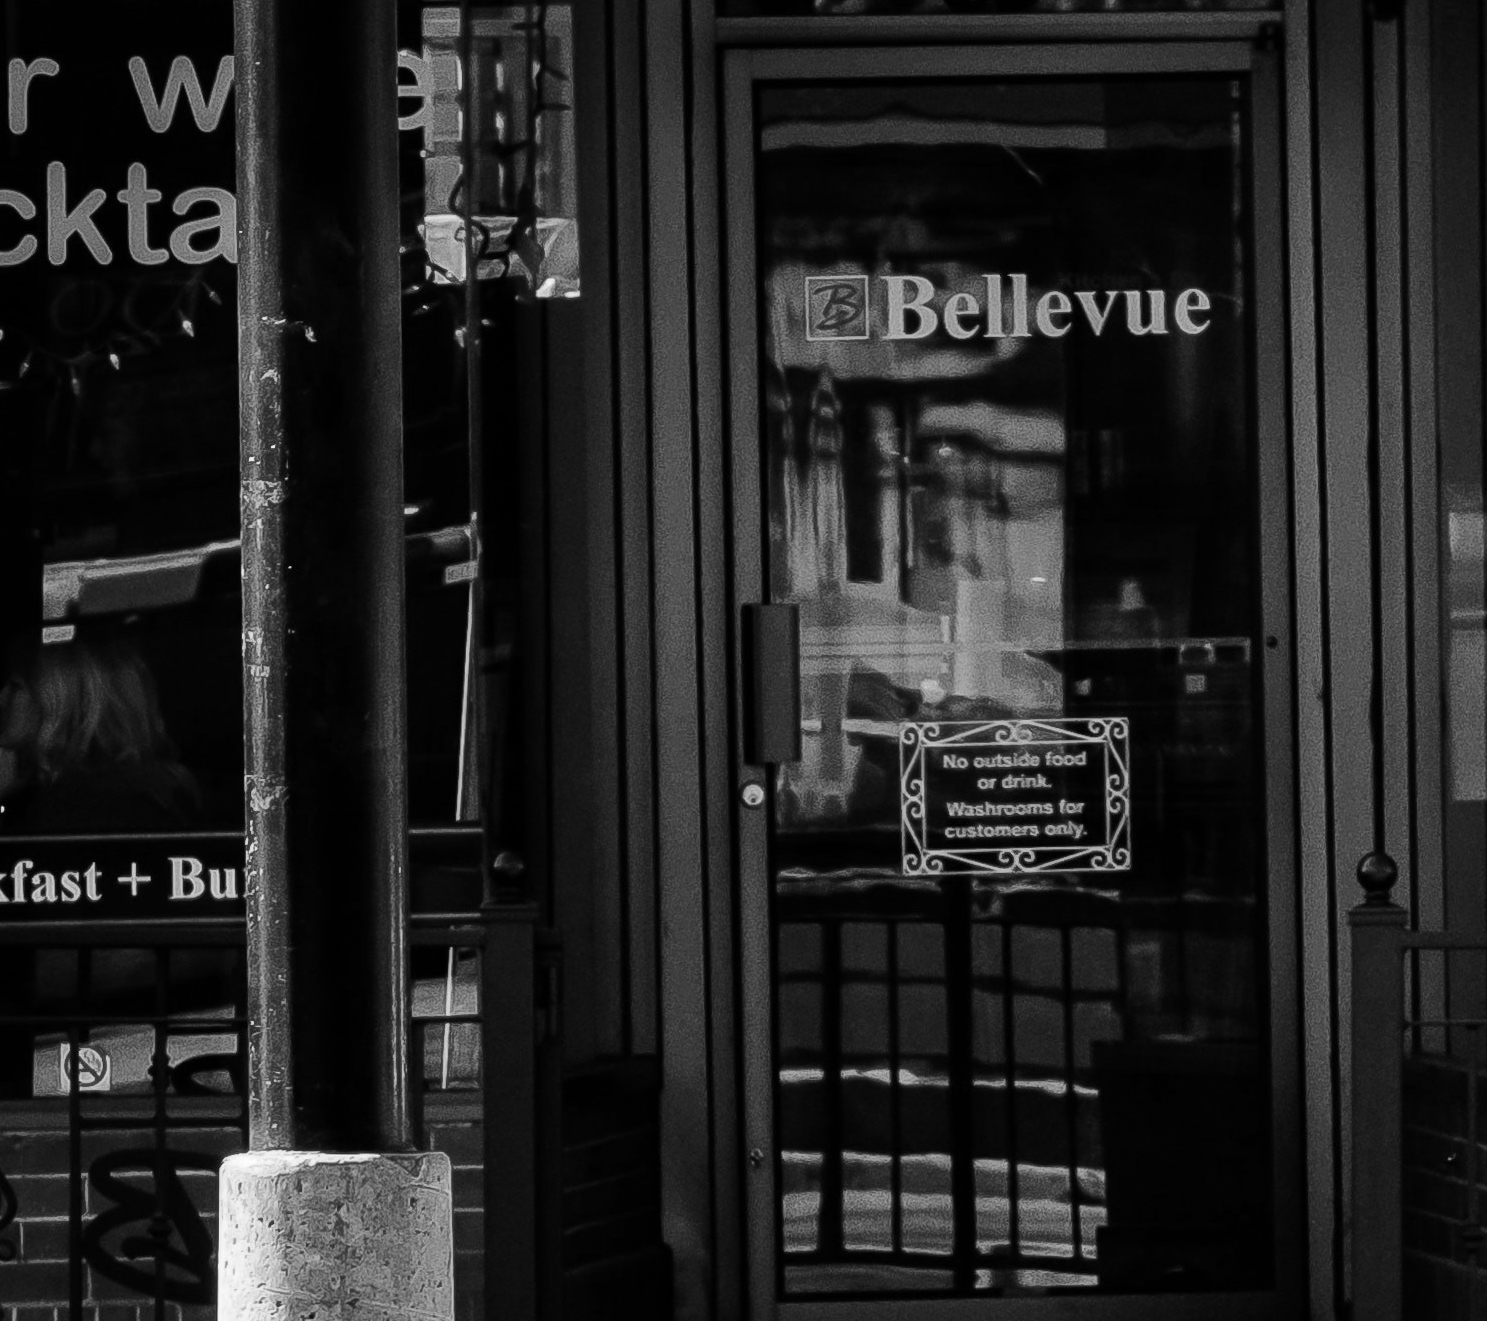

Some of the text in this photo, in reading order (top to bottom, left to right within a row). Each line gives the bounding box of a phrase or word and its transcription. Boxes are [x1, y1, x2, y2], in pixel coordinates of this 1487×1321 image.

[879, 274, 1211, 340] Bellevue
[943, 750, 1087, 769] No outside food
[977, 774, 1052, 789] or drink.
[946, 798, 1085, 816] Washrooms for
[945, 821, 1088, 839] customers only.
